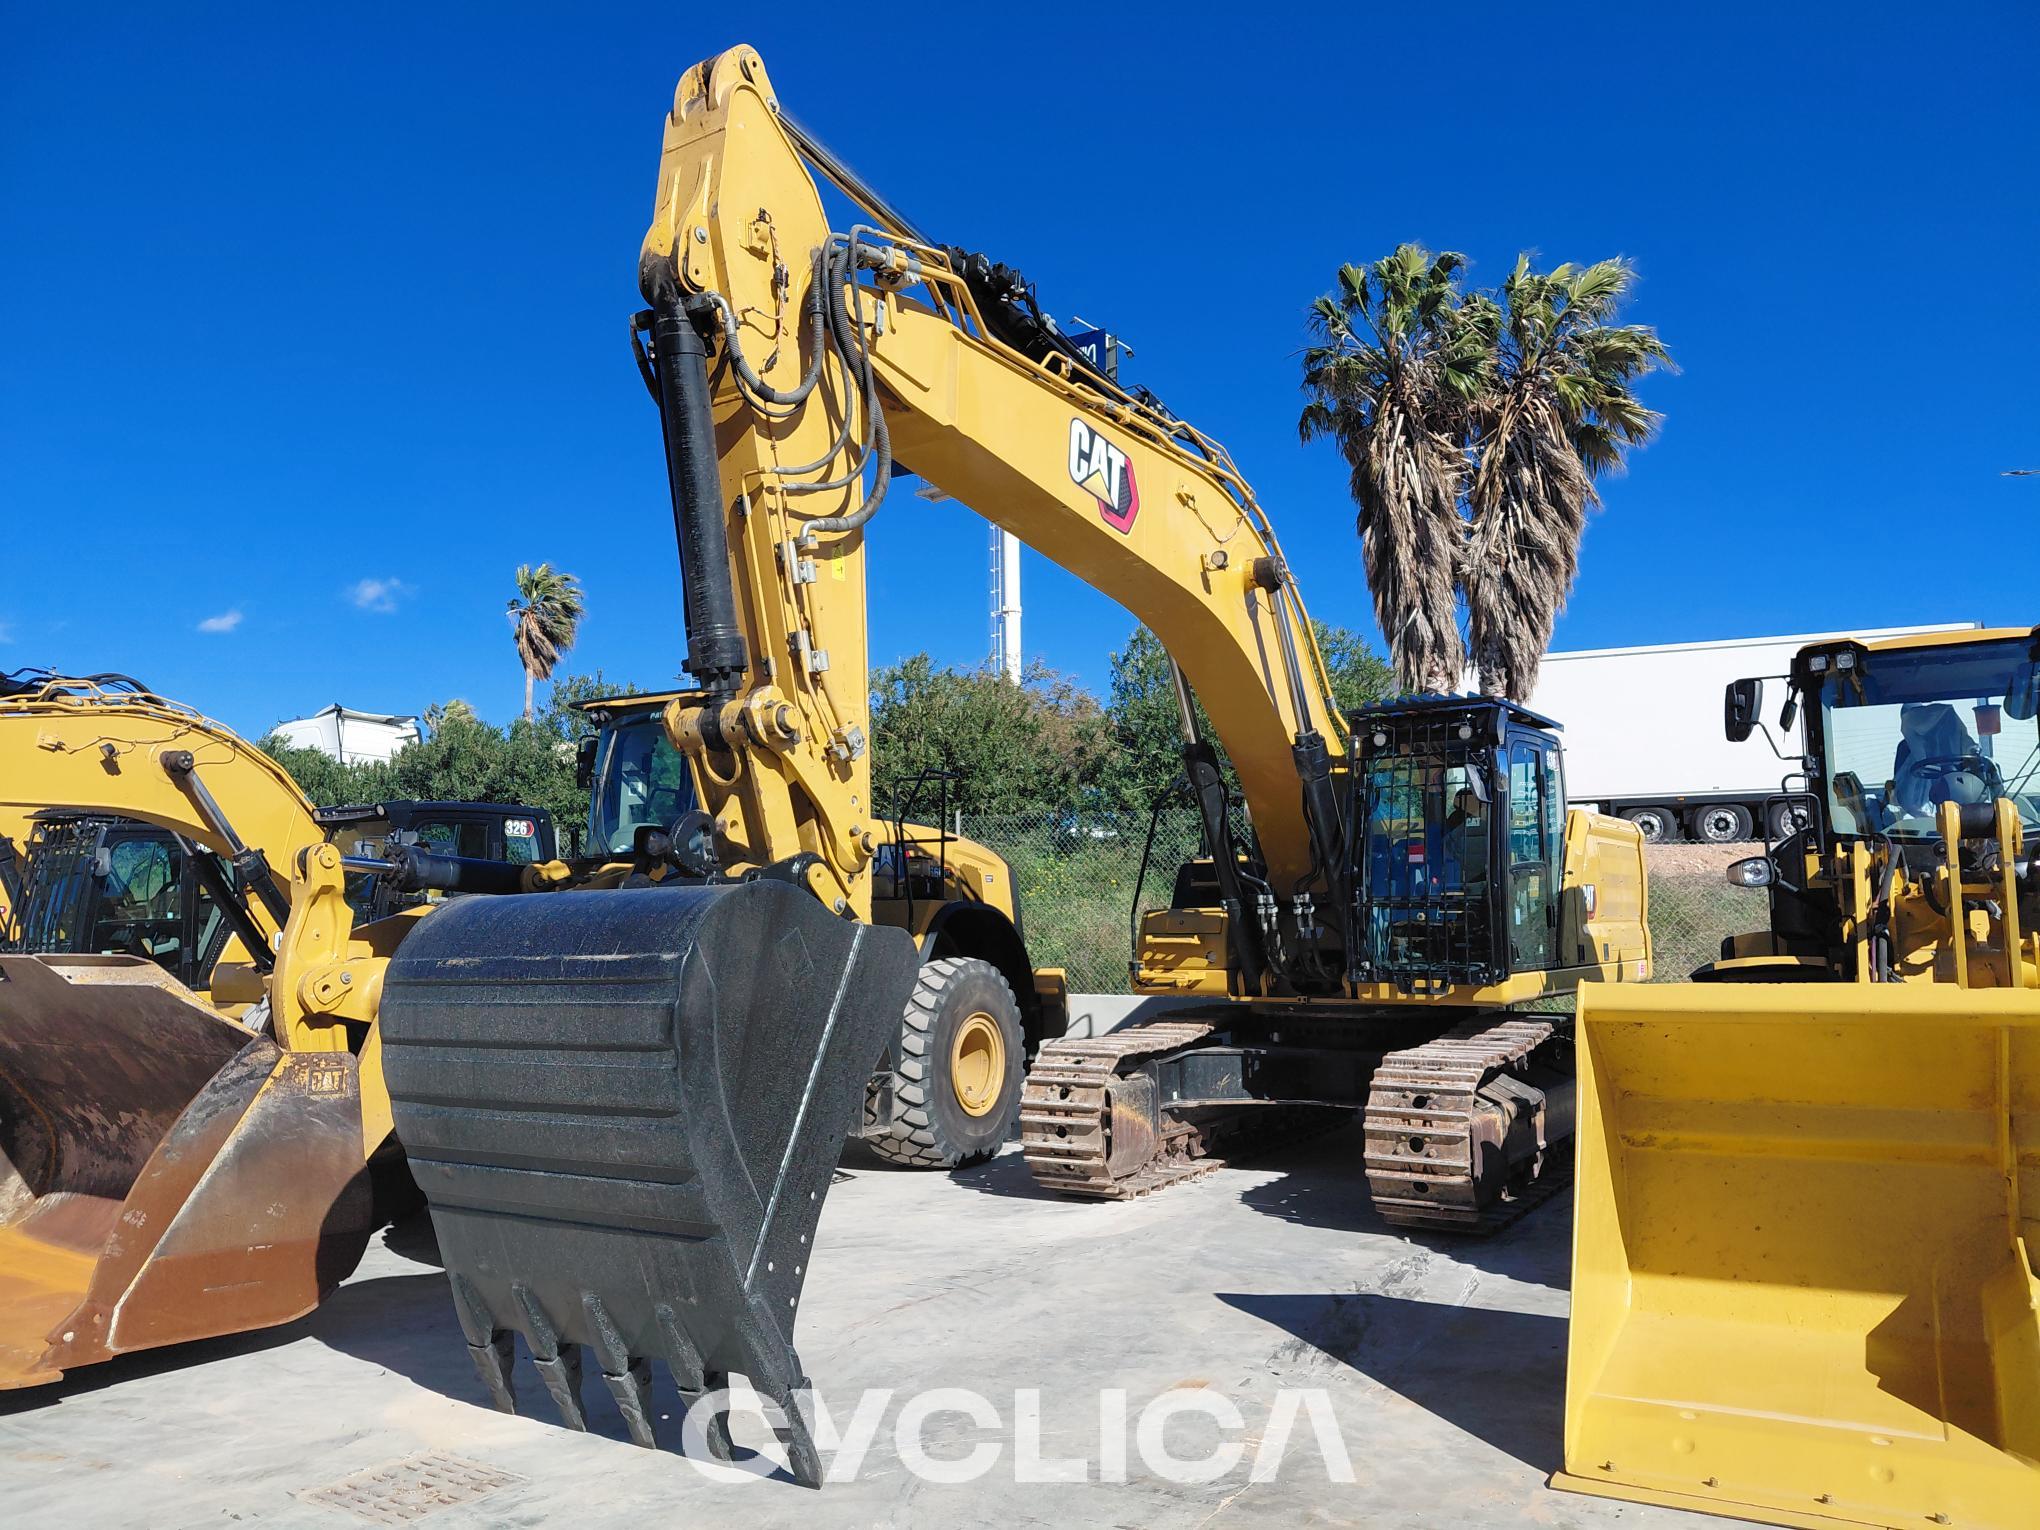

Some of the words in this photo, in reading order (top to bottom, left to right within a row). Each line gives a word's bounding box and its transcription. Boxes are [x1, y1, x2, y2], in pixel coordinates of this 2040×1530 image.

[1069, 418, 1126, 511] CAT
[505, 819, 528, 836] 326
[311, 1070, 343, 1092] CAT
